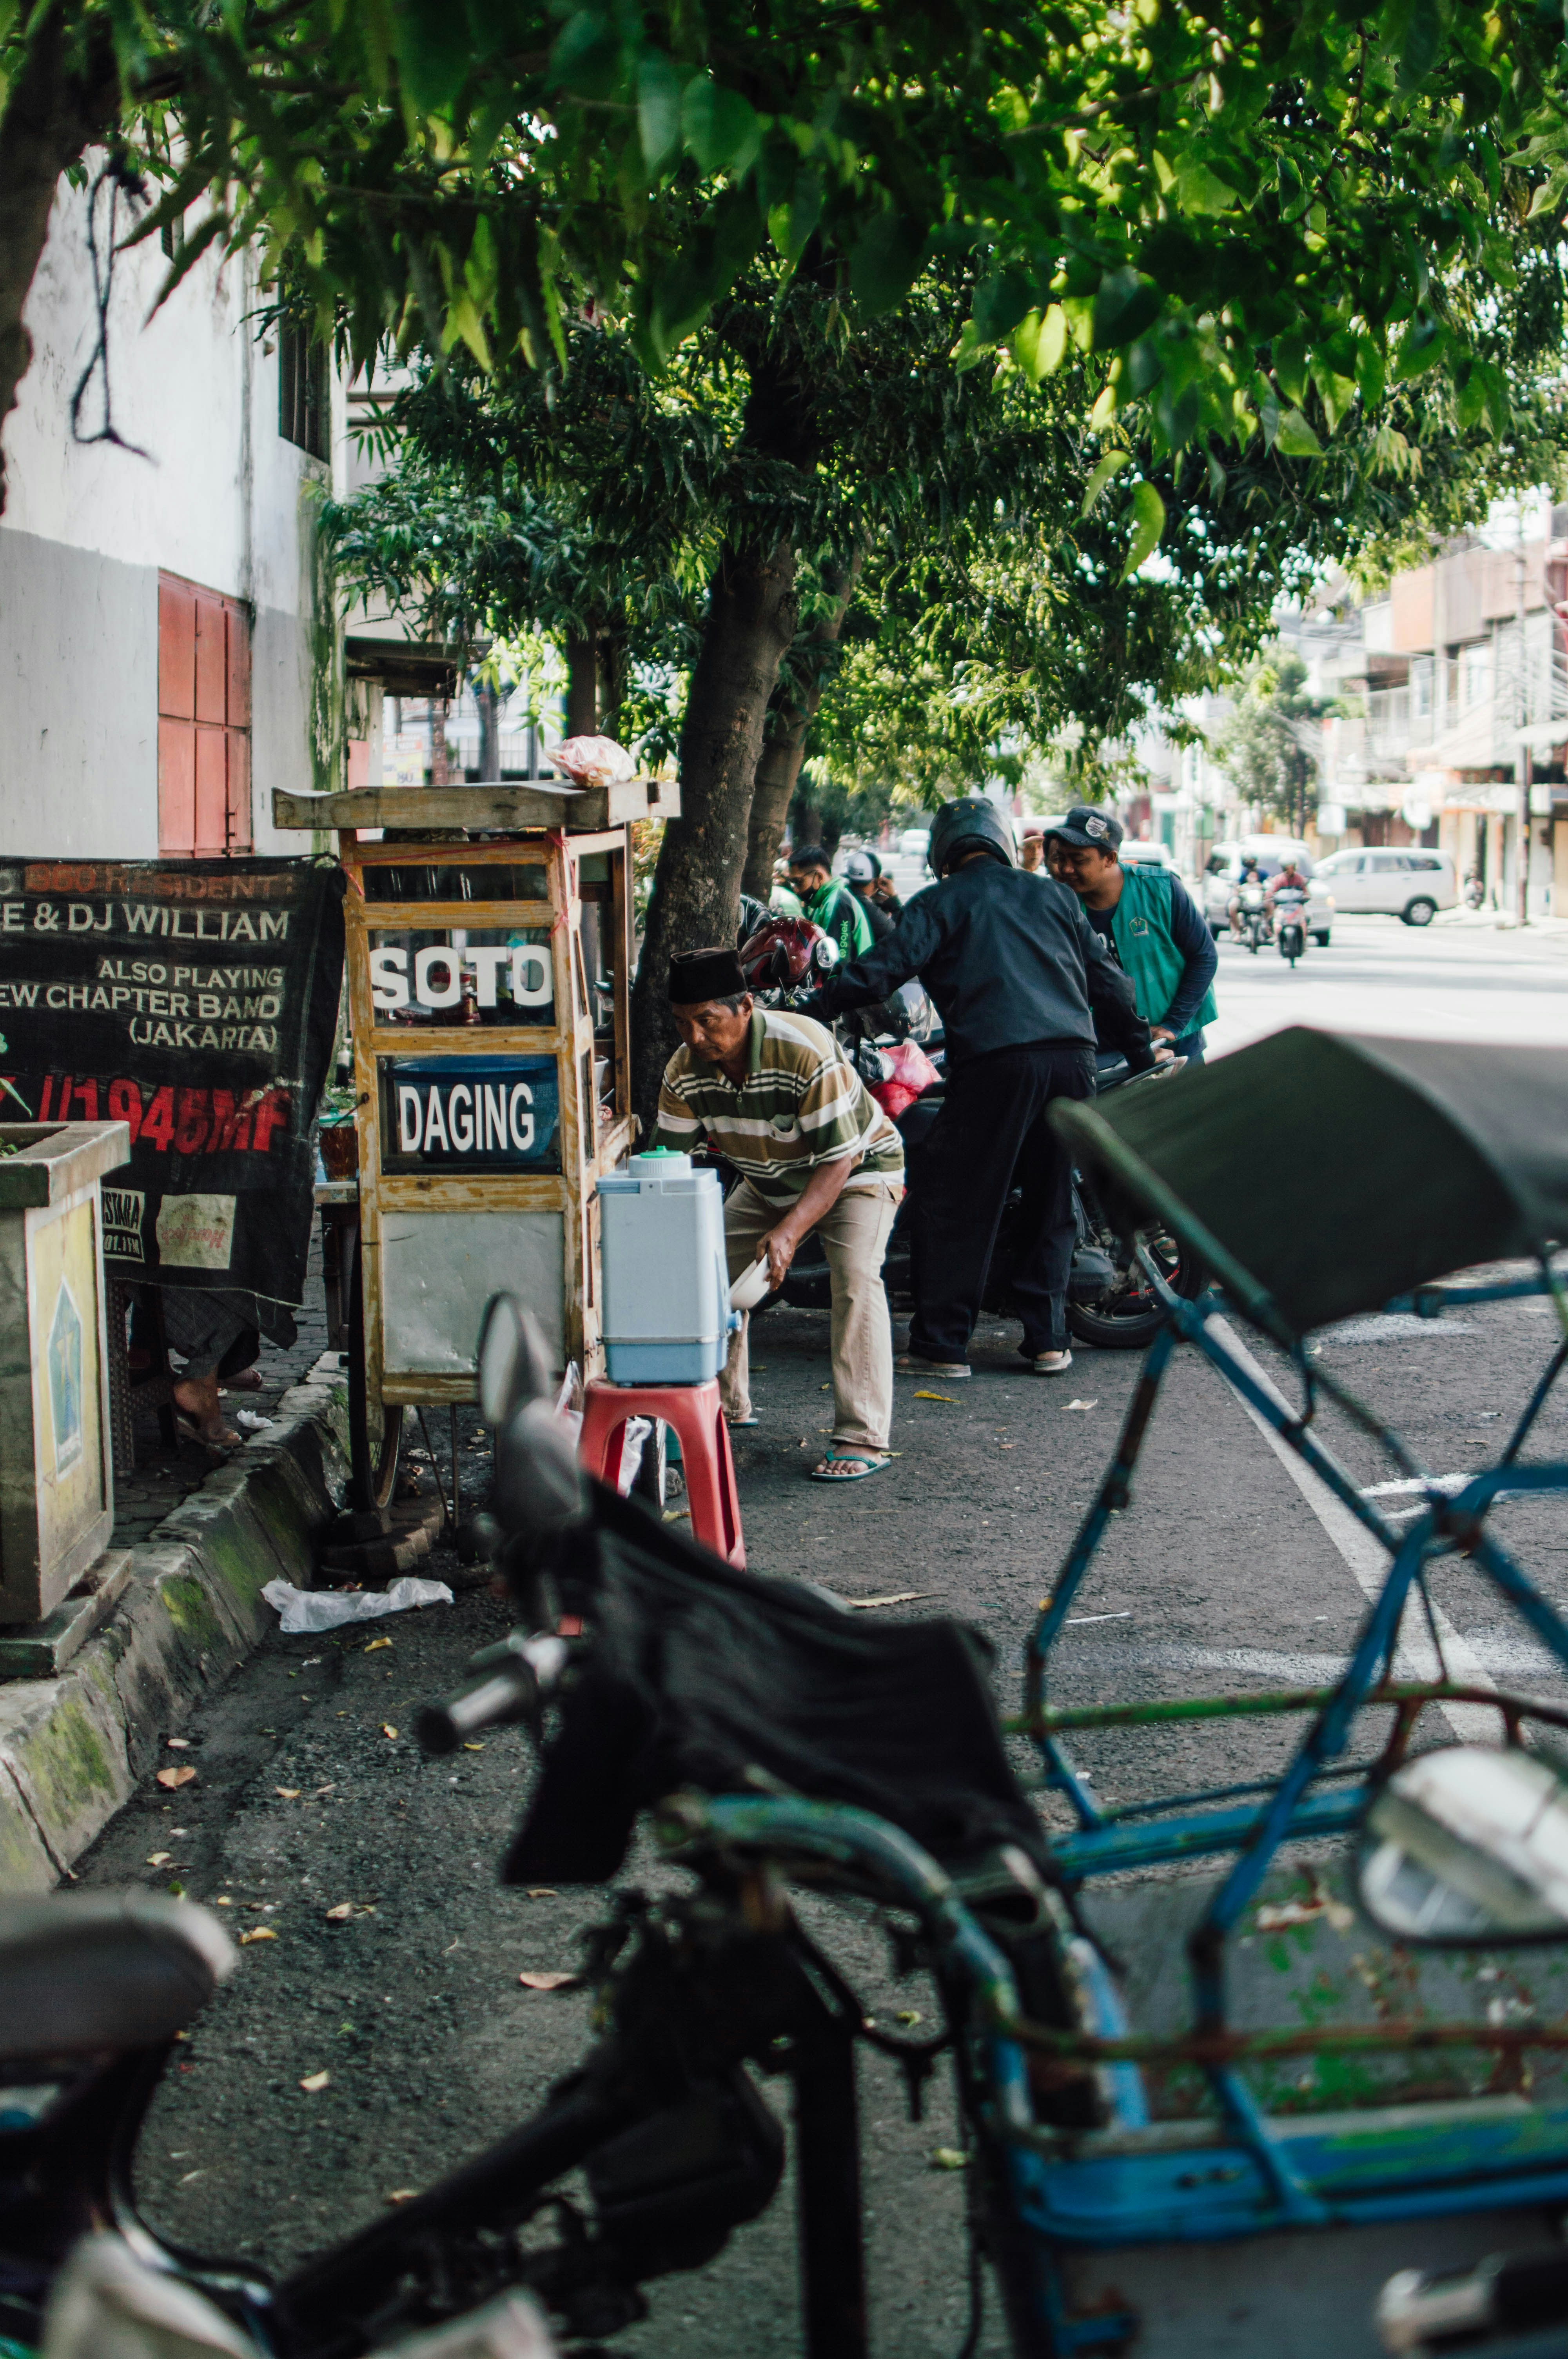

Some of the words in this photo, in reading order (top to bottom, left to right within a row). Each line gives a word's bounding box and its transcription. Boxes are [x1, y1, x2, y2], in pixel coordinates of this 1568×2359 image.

[0, 902, 25, 931] E
[33, 903, 59, 930] &
[68, 903, 113, 931] DJ
[121, 903, 289, 940] WILLIAM
[840, 920, 849, 947] gojek
[98, 960, 167, 985] ALSO
[174, 966, 283, 989] PLAYING
[369, 945, 553, 1009] SOTO
[46, 985, 191, 1016] CHAPTER
[198, 994, 281, 1019] BAND
[129, 1016, 278, 1053] (JAKARTA)
[399, 1083, 534, 1152] DAGING
